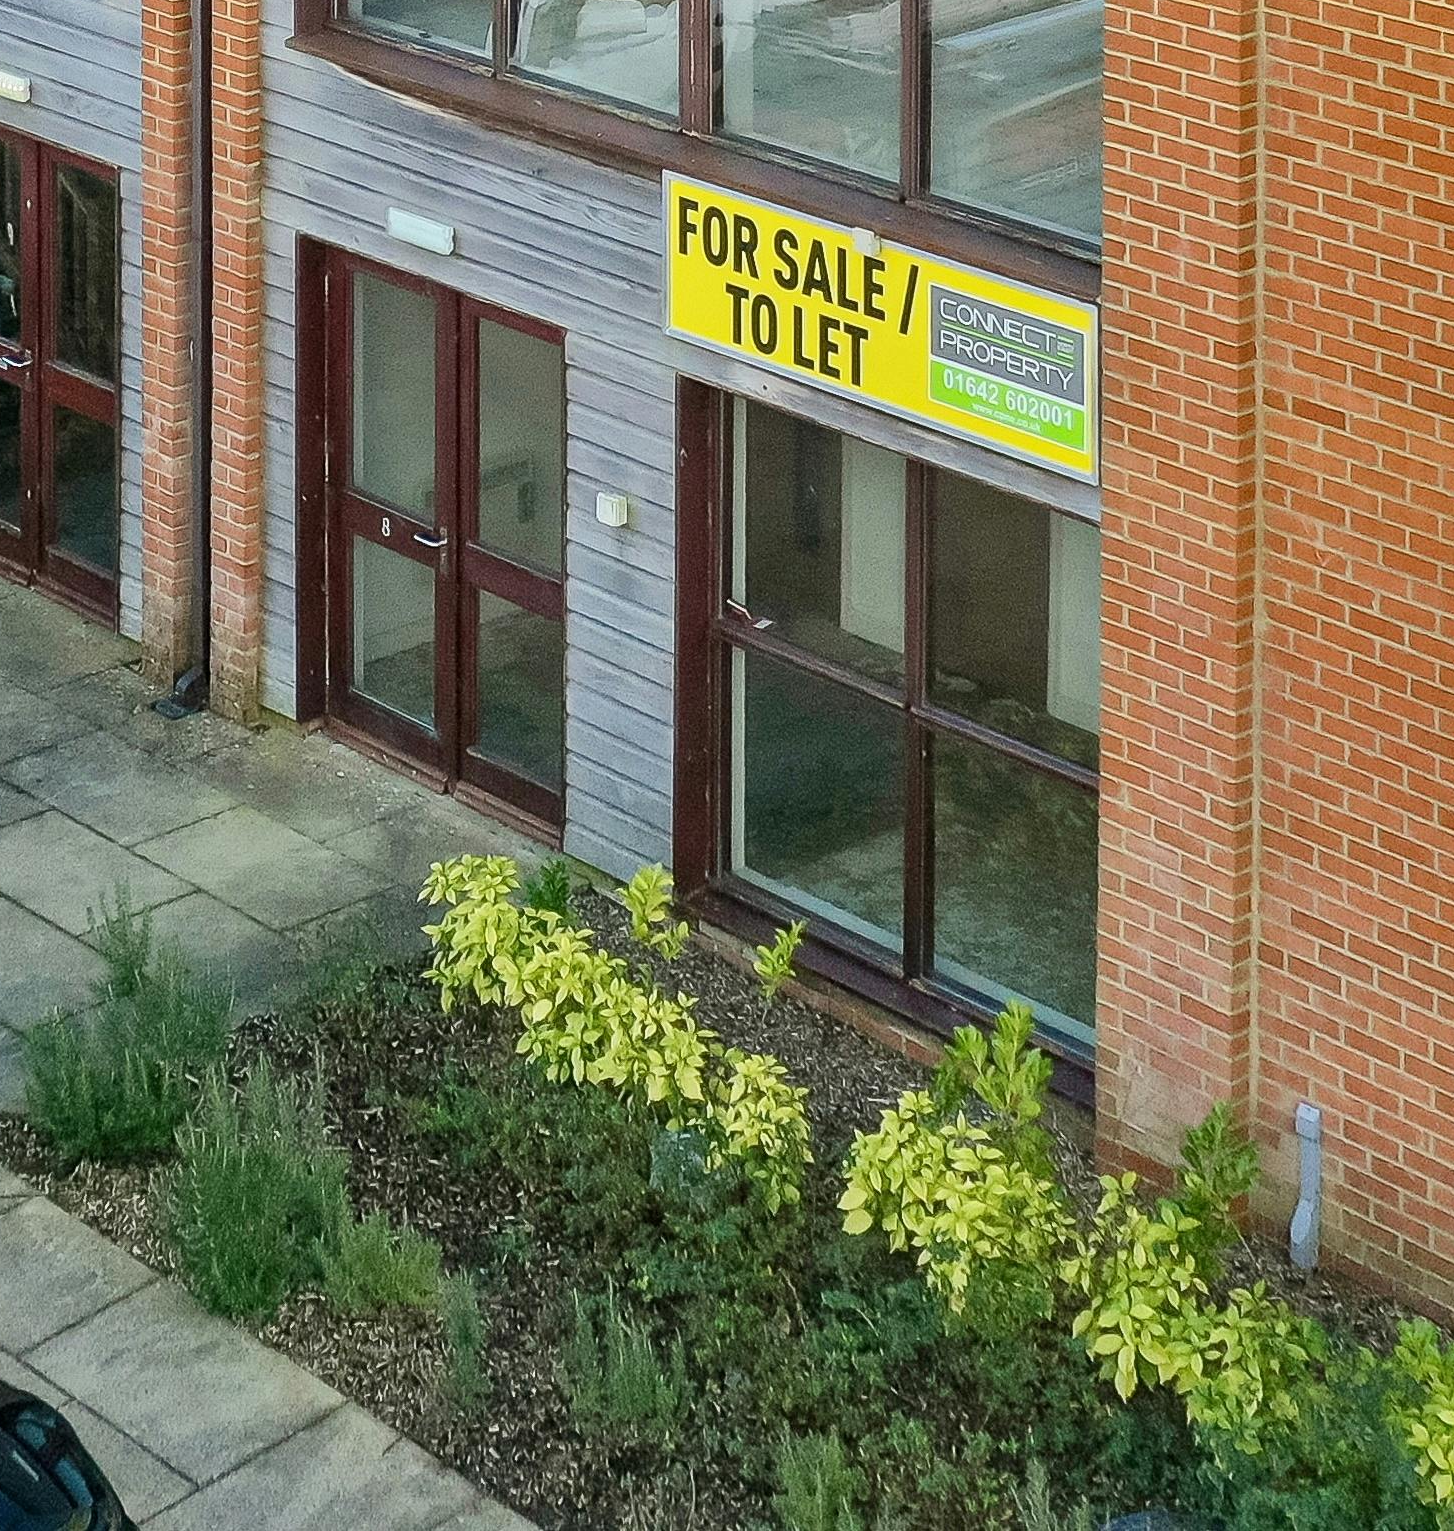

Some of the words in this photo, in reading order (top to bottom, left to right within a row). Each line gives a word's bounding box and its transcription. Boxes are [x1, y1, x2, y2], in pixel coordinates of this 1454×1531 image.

[678, 195, 759, 280] FOR
[773, 228, 887, 323] SALE
[898, 264, 920, 336] /
[725, 283, 778, 355] TO
[793, 305, 869, 388] LET
[940, 329, 1074, 391] PROPERTY
[943, 369, 999, 406] 01642
[1005, 389, 1074, 431] 602001
[382, 517, 390, 537] 8
